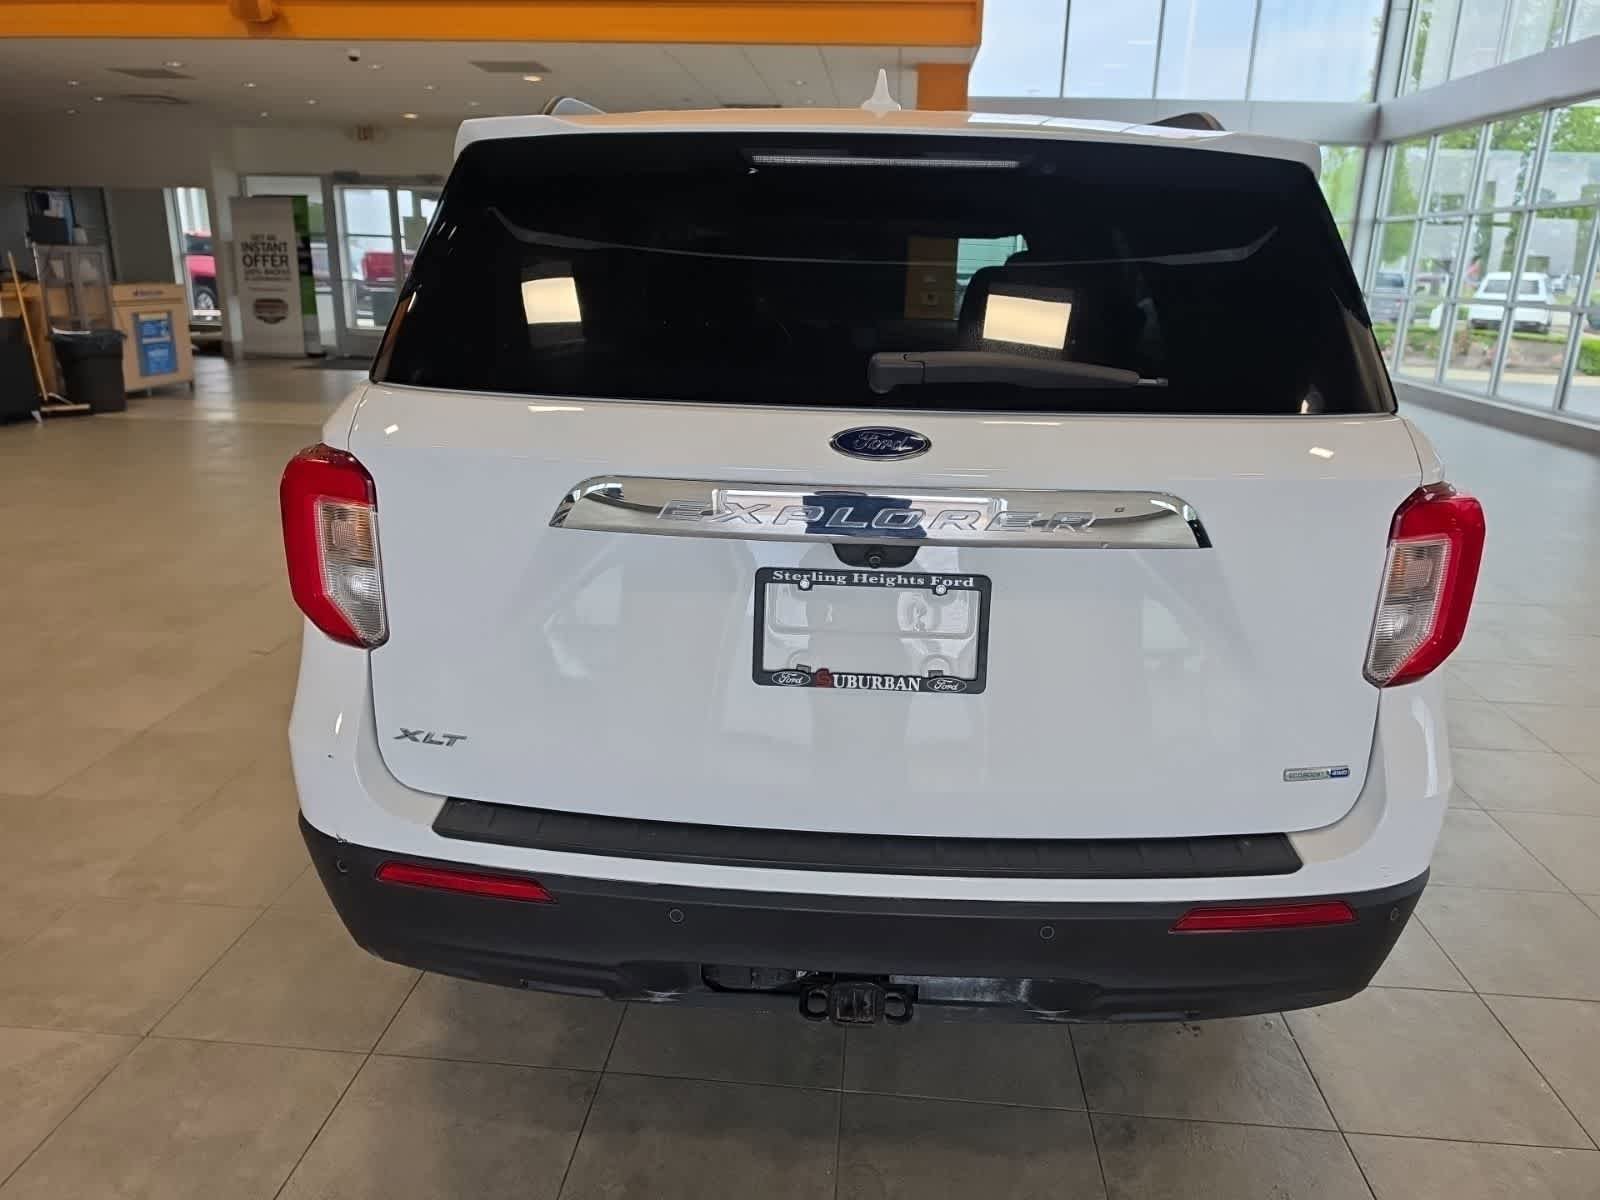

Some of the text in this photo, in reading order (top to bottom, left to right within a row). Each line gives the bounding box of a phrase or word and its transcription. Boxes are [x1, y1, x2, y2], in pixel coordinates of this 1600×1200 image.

[241, 242, 288, 253] INSTANT
[242, 254, 289, 268] OFFER
[656, 500, 1097, 533] EXPLORER
[772, 570, 975, 587] Sterling Heights Ford
[816, 668, 921, 691] SUBURBAN
[393, 727, 468, 747] XLT
